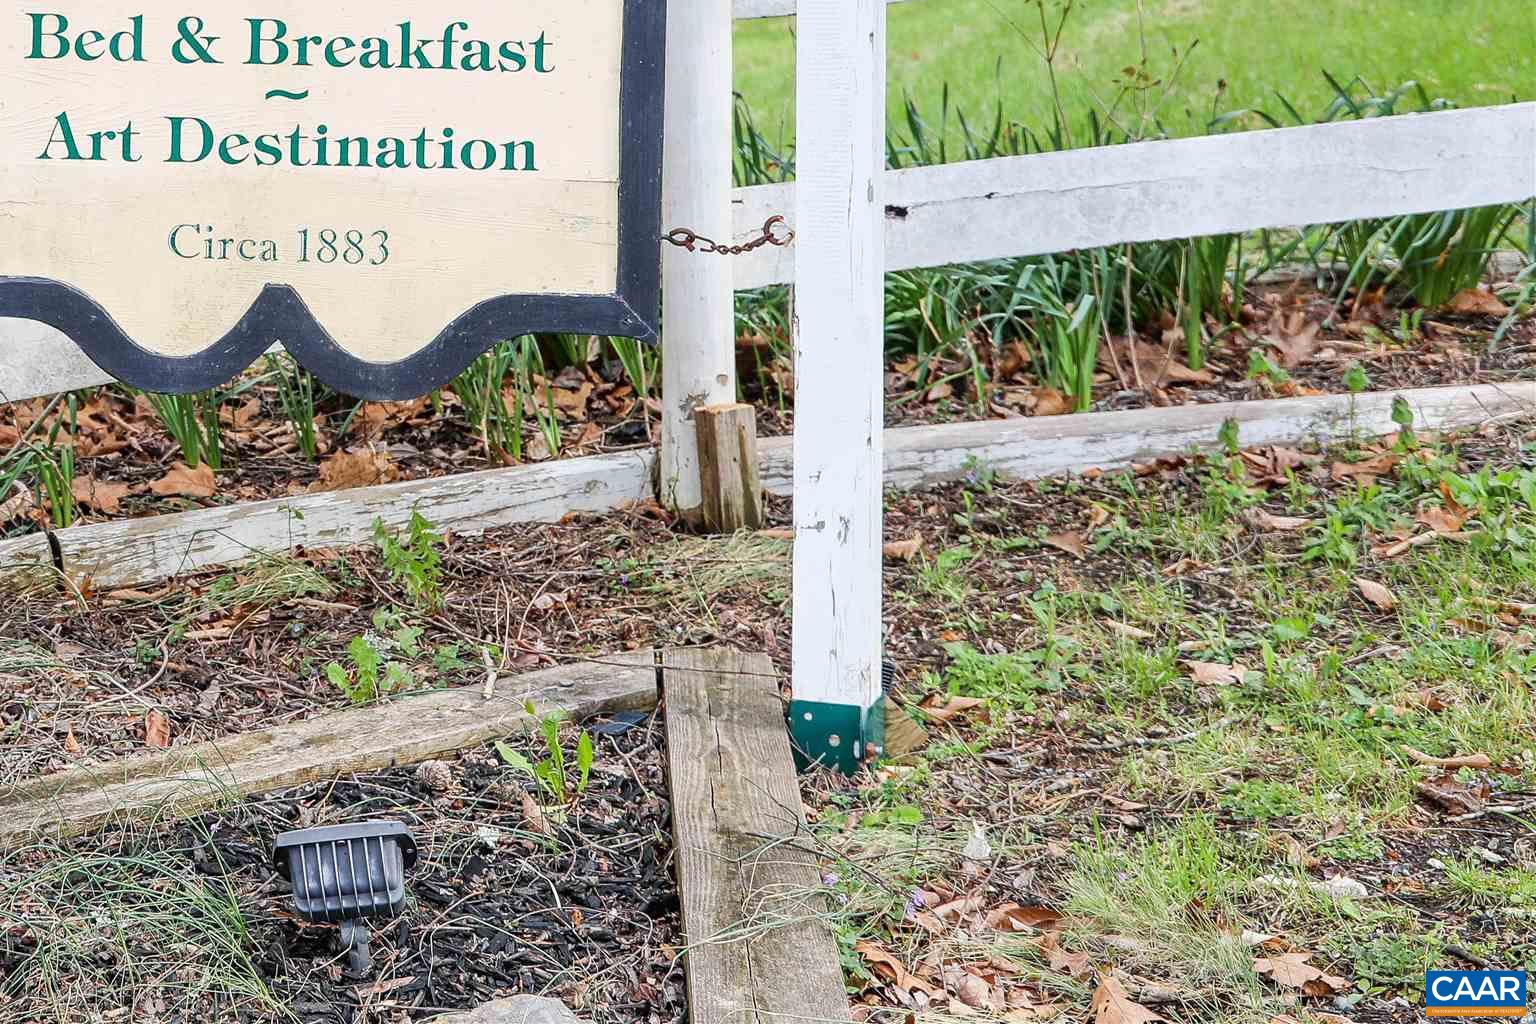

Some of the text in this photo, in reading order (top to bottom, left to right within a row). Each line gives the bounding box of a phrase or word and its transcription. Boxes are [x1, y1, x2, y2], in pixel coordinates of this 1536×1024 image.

[24, 12, 556, 74] Bed & Breakfast
[36, 111, 538, 172] Art Destination
[167, 224, 390, 265] Circa 1883
